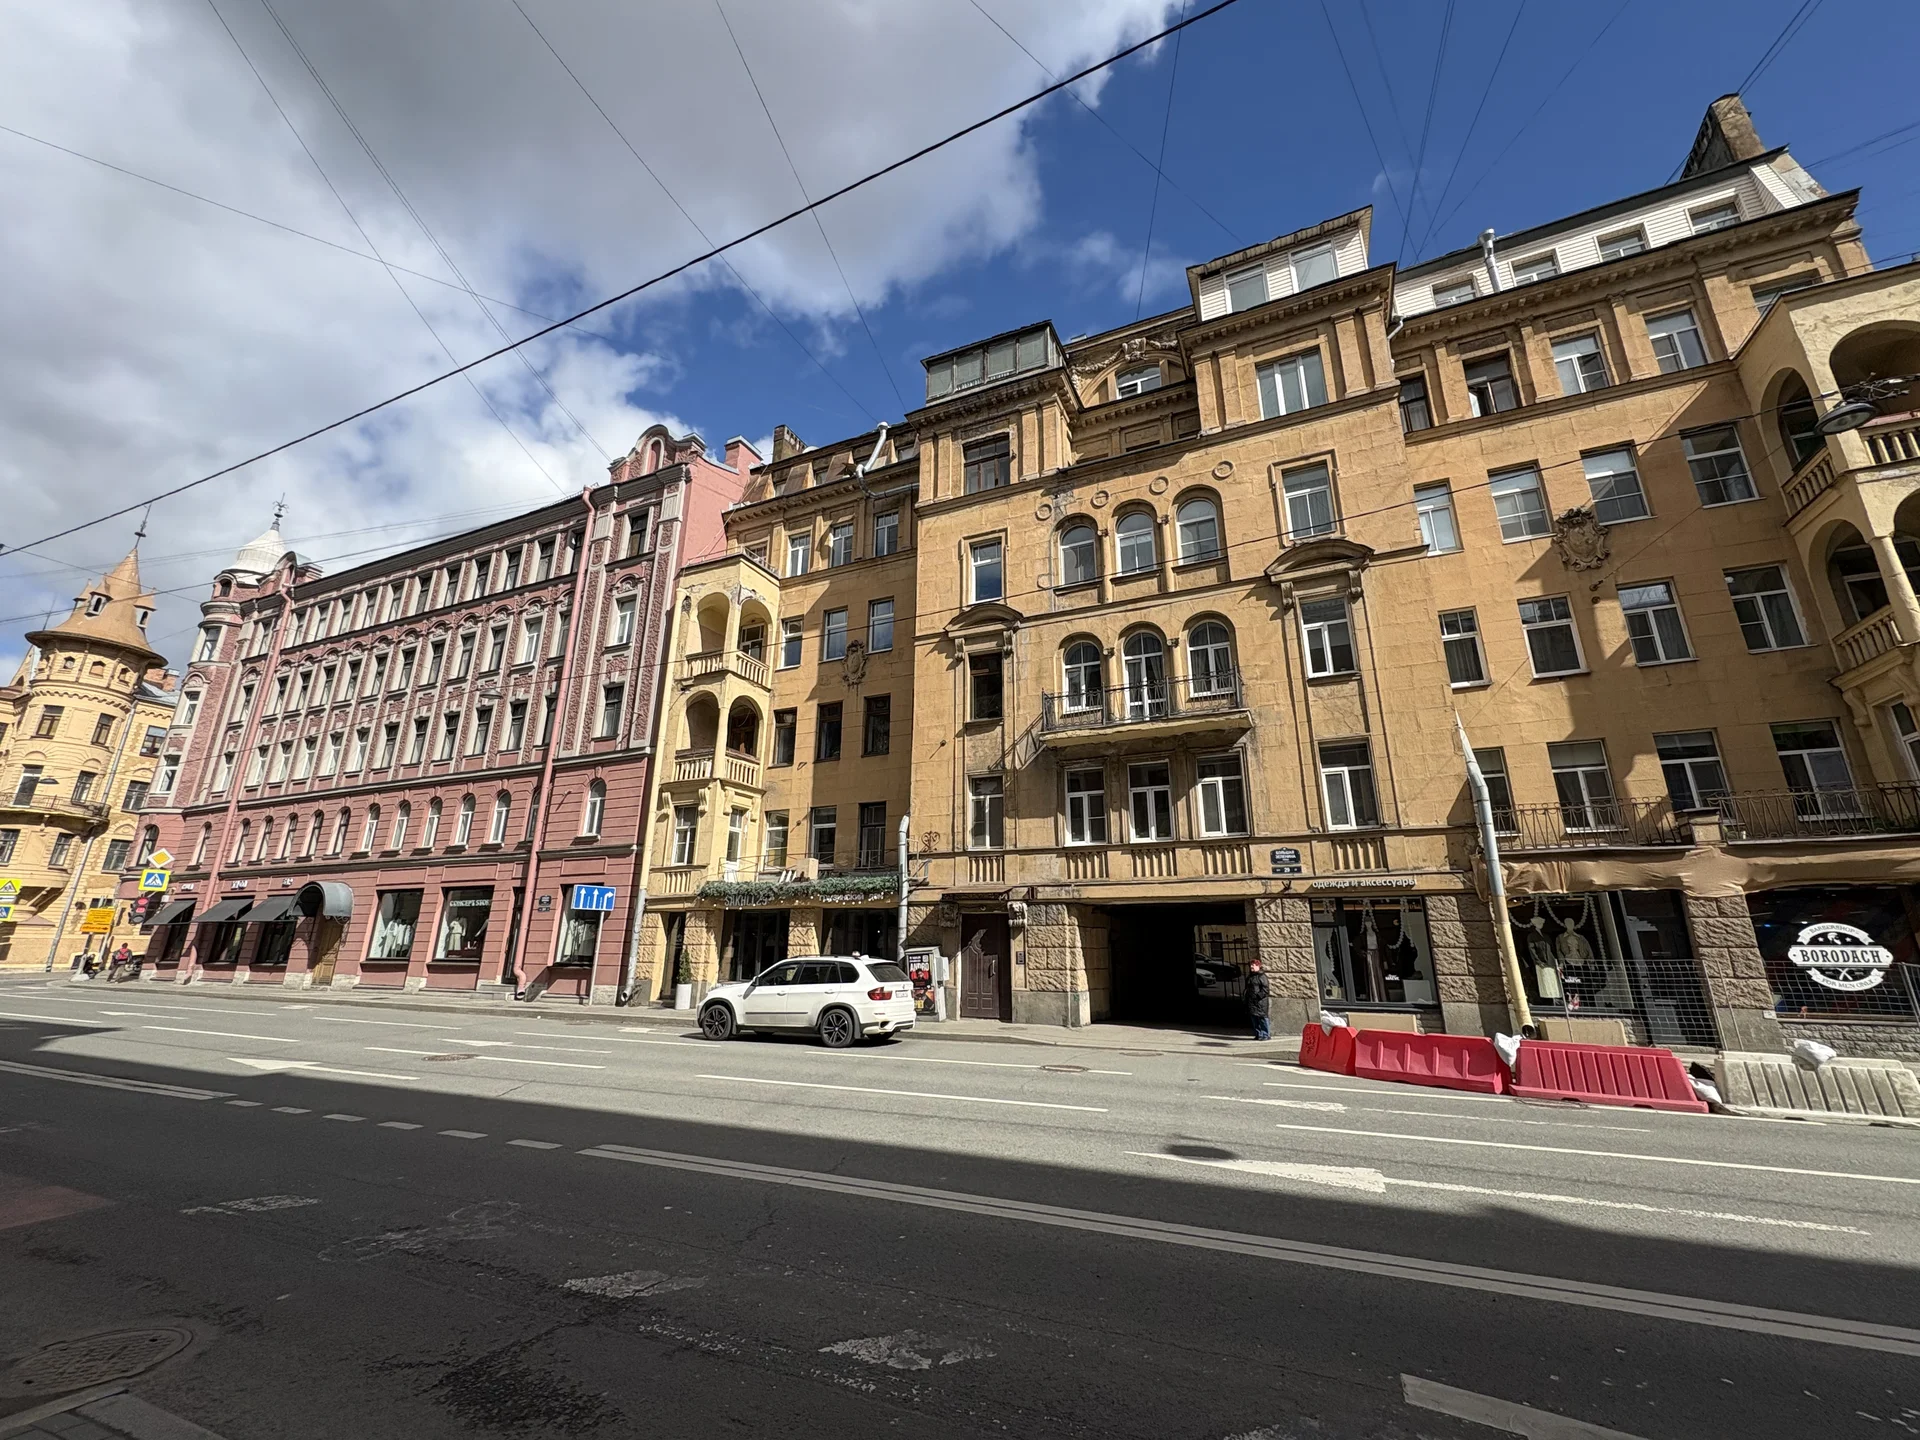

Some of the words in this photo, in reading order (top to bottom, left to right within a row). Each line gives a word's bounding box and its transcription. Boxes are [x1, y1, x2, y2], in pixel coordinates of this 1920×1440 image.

[1312, 879, 1350, 889] одежда
[1351, 880, 1358, 888] и
[1360, 878, 1418, 888] аксессуары
[1800, 949, 1883, 963] BORODACH
[1821, 978, 1837, 987] FOR
[1856, 978, 1874, 988] ONLY
